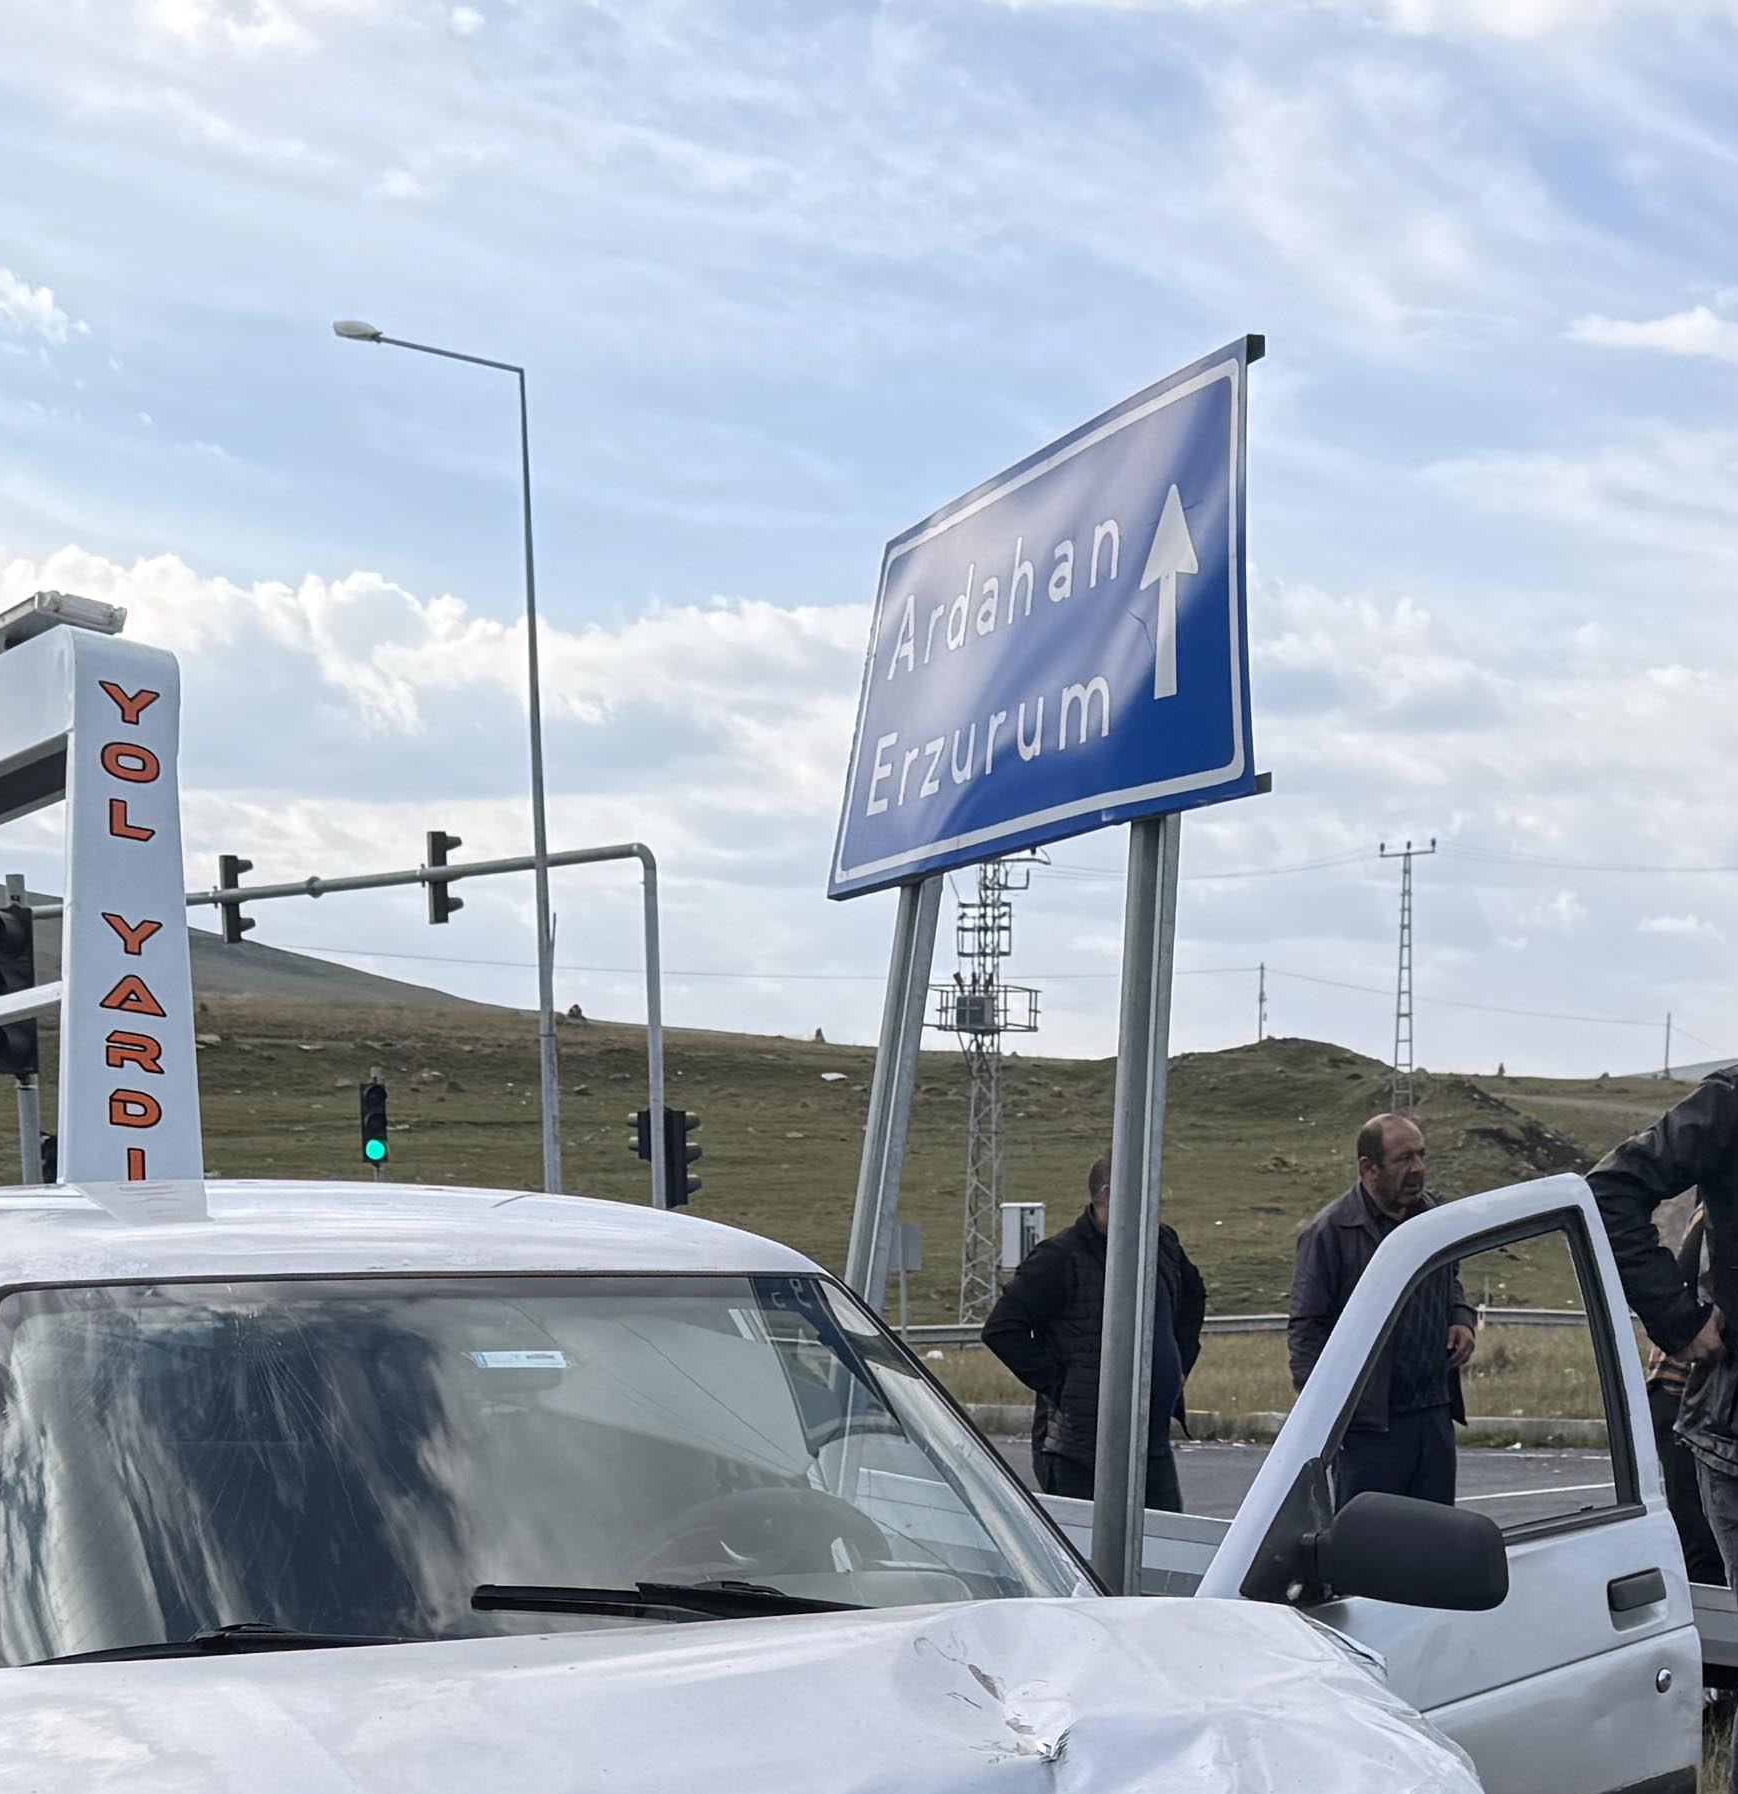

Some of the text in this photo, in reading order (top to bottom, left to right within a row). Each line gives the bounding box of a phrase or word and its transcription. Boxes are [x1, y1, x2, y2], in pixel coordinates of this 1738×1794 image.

[887, 517, 1120, 681] Ardahan
[866, 676, 1111, 817] Erzurum
[98, 680, 167, 1182] YOL YARDI
